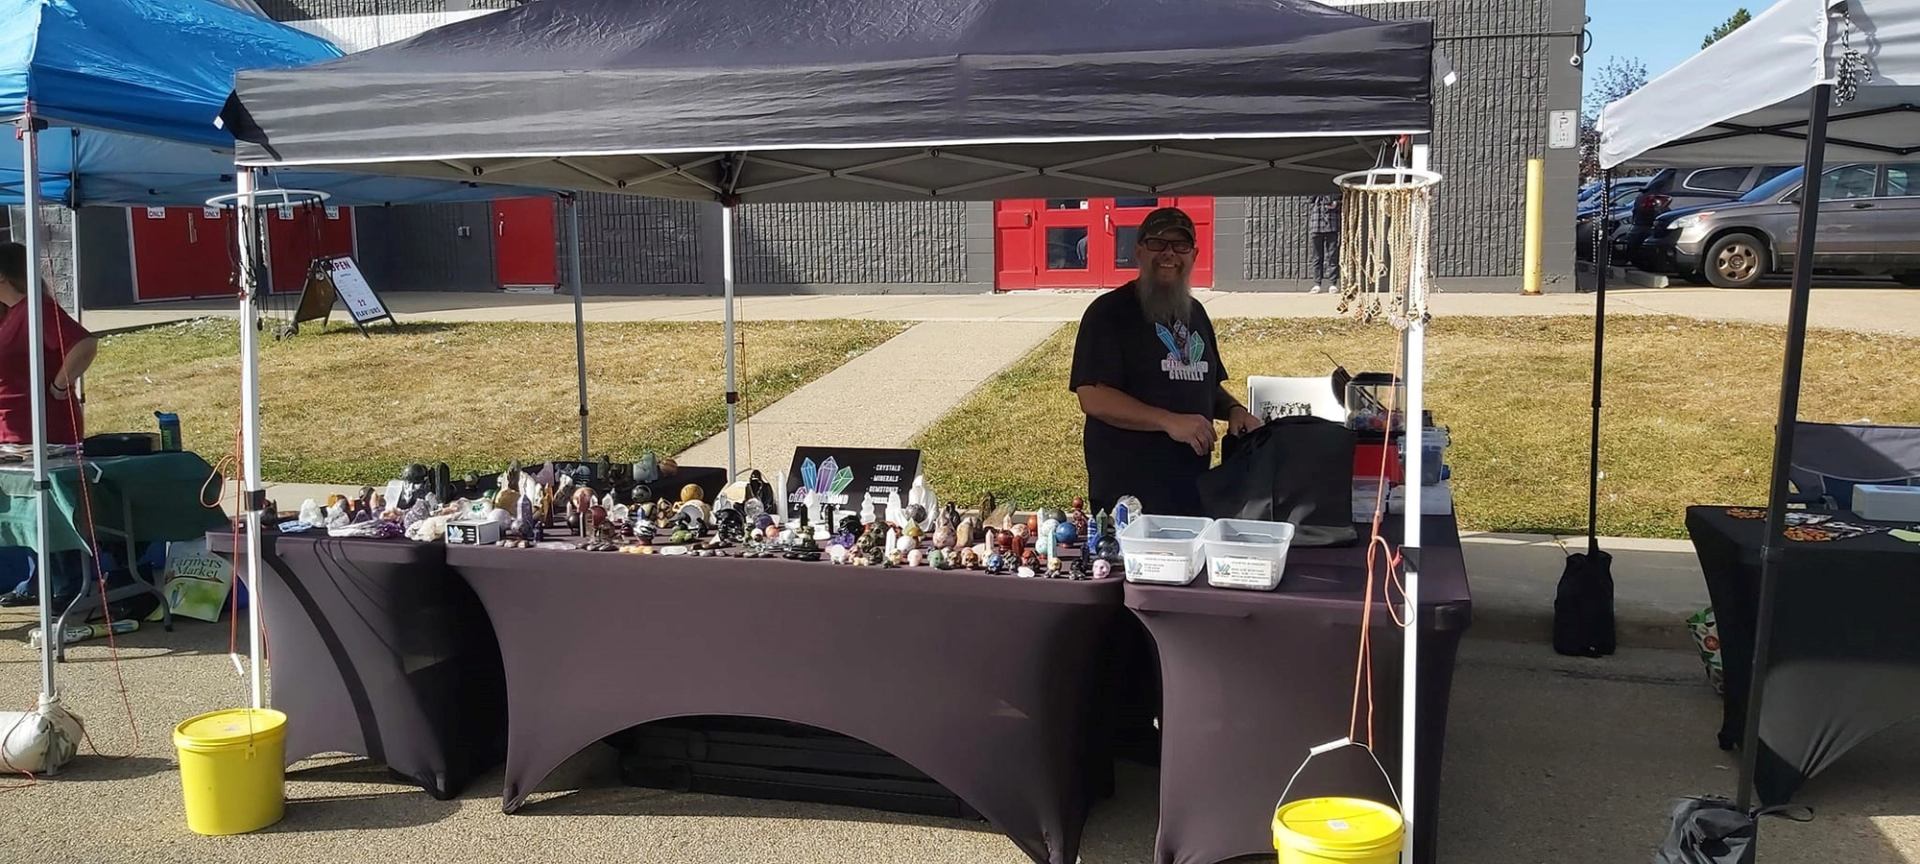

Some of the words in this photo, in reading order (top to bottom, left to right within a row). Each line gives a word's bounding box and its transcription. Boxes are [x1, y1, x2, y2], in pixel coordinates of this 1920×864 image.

[875, 464, 902, 472] CRYSTALS
[873, 475, 899, 483] MINERALS
[176, 566, 219, 577] Market
